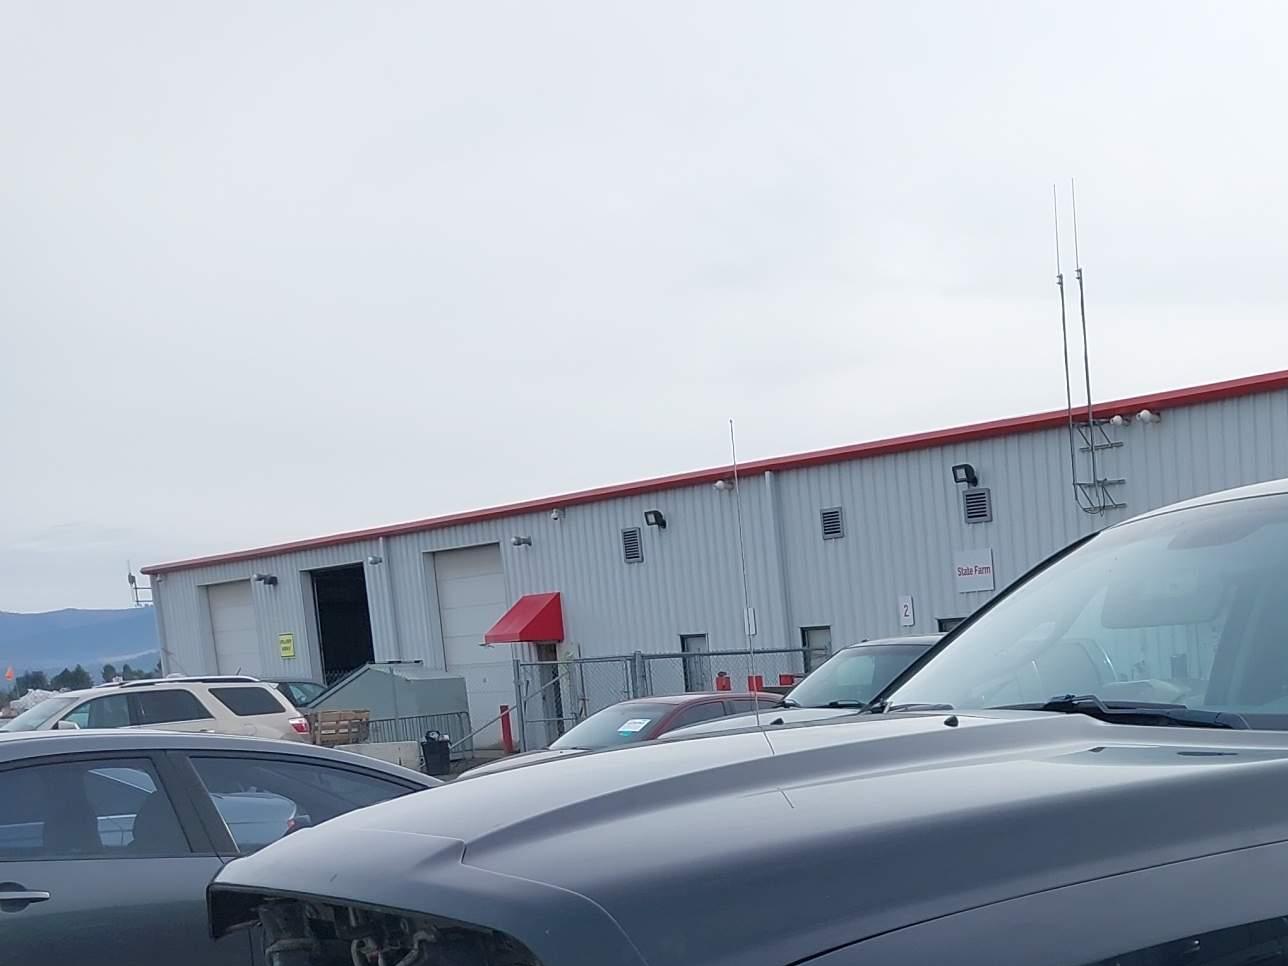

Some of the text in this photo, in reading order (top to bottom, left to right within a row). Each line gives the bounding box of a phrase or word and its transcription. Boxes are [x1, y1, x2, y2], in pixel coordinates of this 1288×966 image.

[957, 565, 991, 576] State Farm
[903, 604, 910, 617] 2
